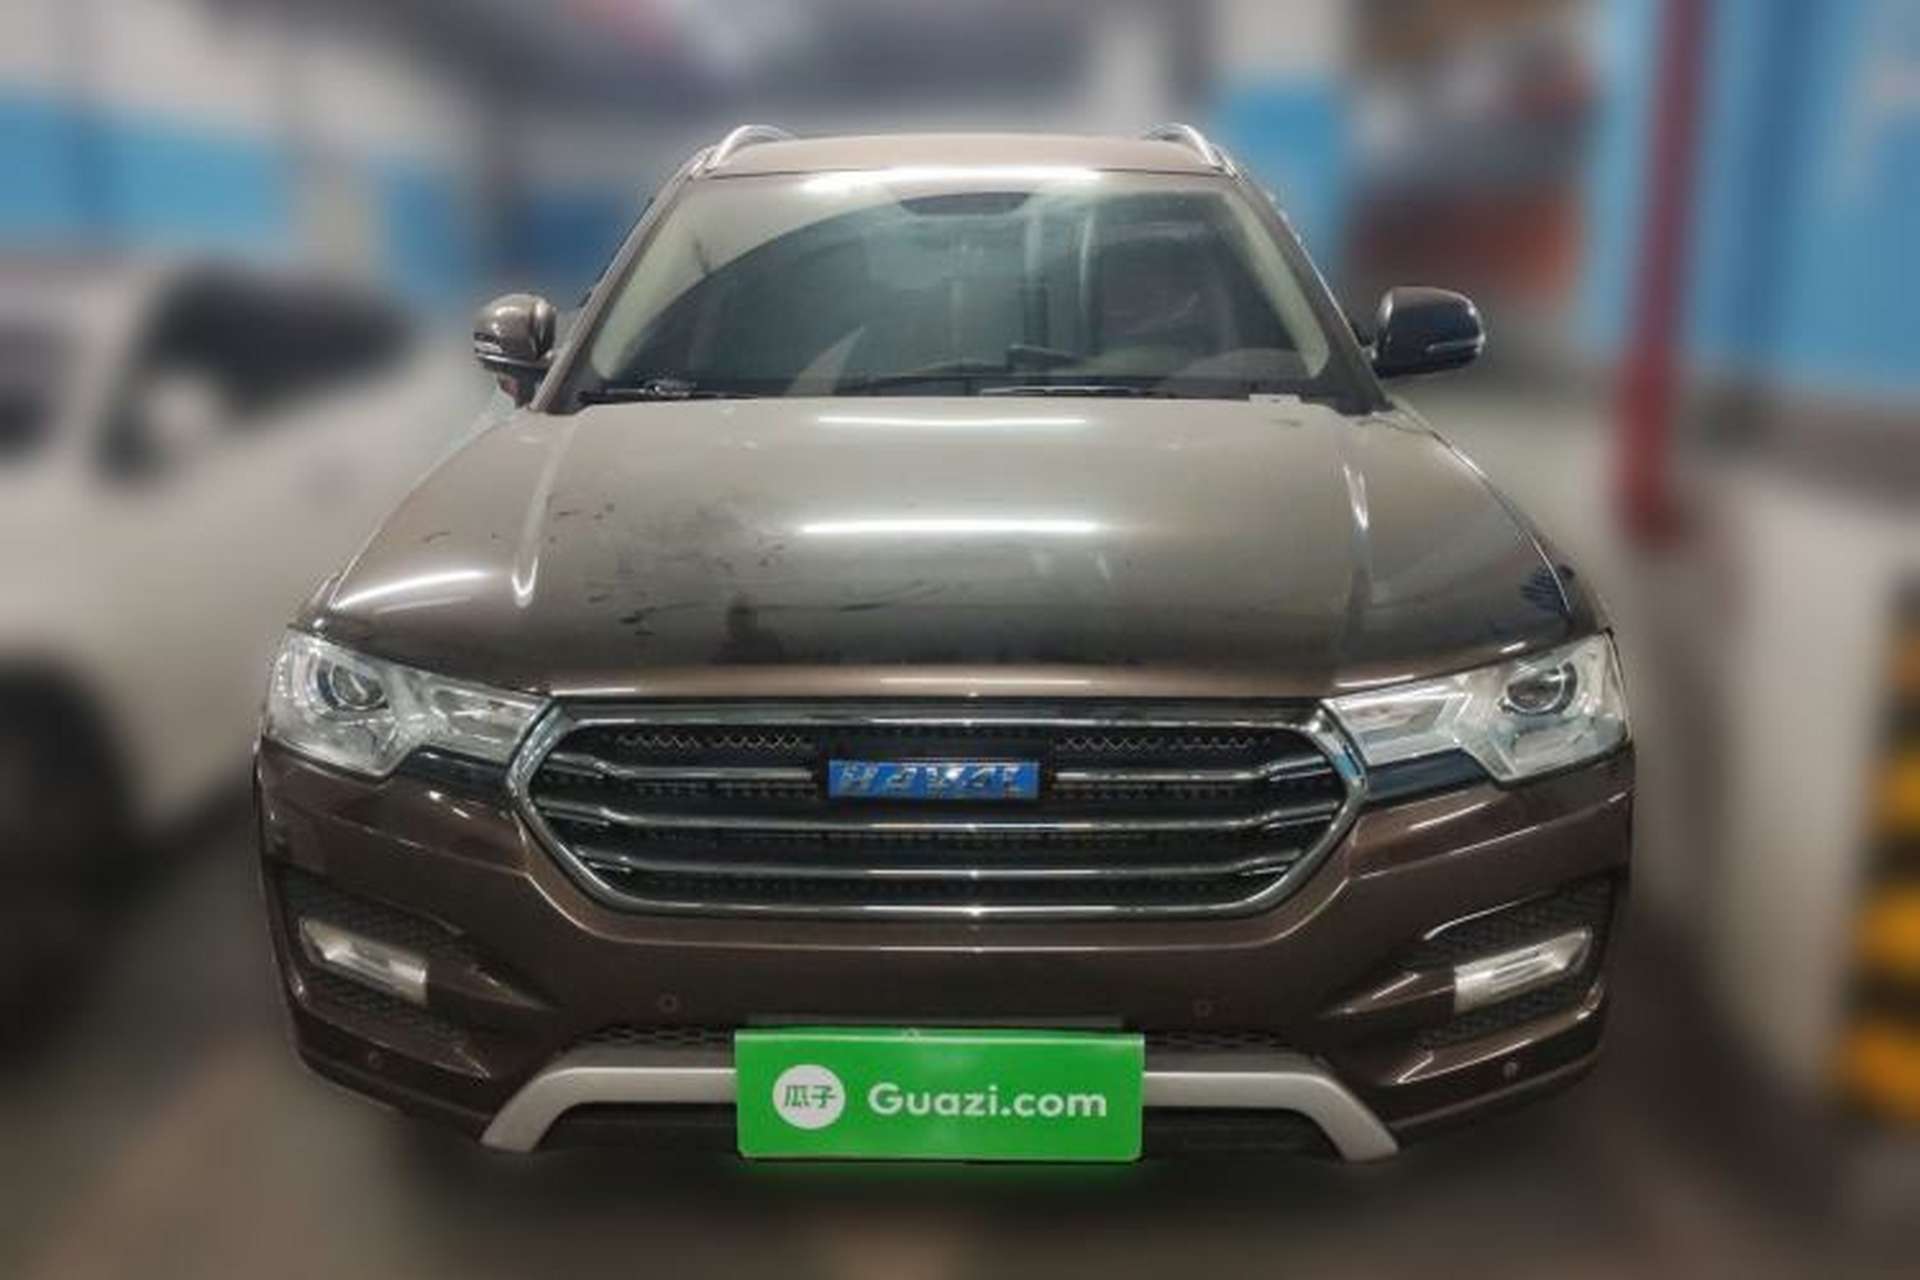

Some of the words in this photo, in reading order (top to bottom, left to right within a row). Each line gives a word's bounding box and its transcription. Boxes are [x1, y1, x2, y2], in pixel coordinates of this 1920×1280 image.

[839, 763, 1026, 797] HAVAL
[784, 1083, 836, 1109] 瓜子
[867, 1082, 1107, 1118] Guazi.com
